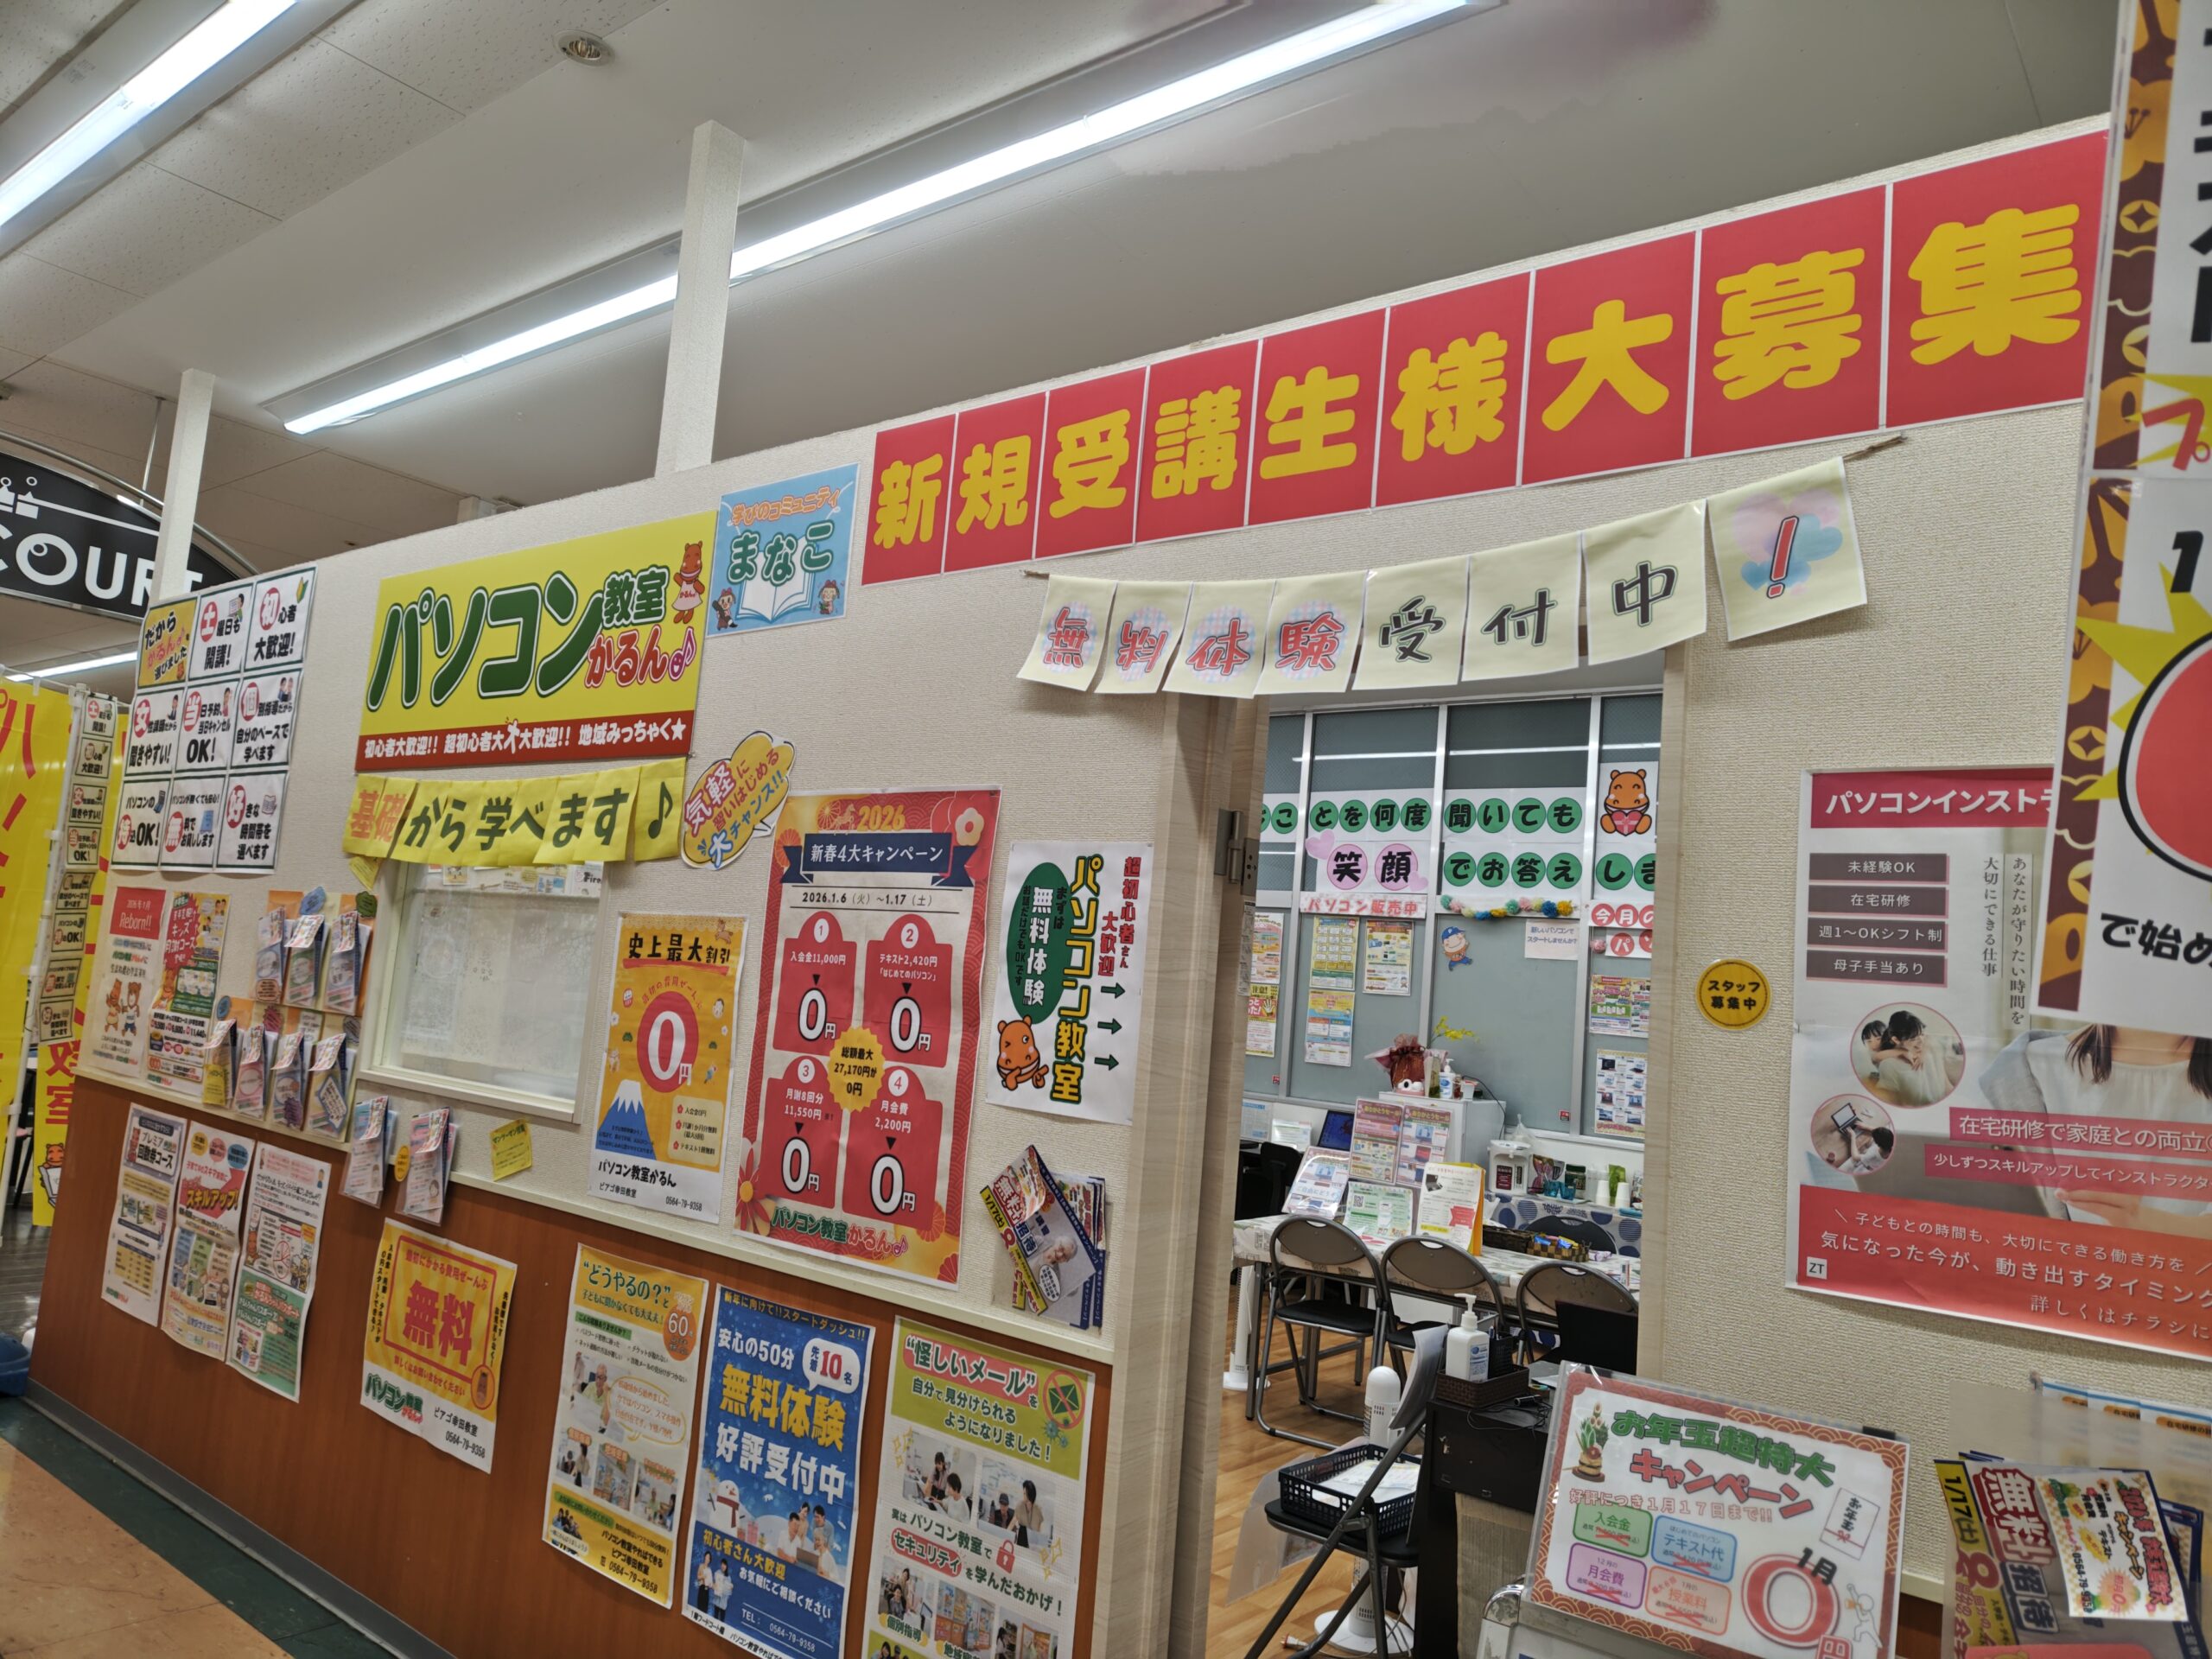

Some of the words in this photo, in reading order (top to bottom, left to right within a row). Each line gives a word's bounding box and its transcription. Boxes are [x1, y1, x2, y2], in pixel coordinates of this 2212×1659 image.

[873, 203, 2082, 549] 新規受講生様大募集
[732, 486, 840, 526] 学びのコミュニティ
[727, 519, 835, 587] まなこ
[258, 588, 296, 631] 初心者
[602, 564, 670, 629] 教室
[1043, 513, 1801, 677] 無料体験受付中!
[145, 612, 176, 650] だから
[200, 601, 240, 642] 土曜日も
[204, 645, 232, 670] 開講!
[254, 632, 295, 662] 大歓迎!
[366, 570, 605, 712] パソコン
[584, 625, 669, 688] かるん
[154, 645, 188, 680] 選びました
[198, 719, 231, 734] 当日キャンセル
[236, 723, 289, 745] 自分のペースで
[129, 745, 171, 767] 聞きやすい!
[186, 738, 215, 764] OK!
[243, 745, 276, 762] 学べます
[365, 736, 439, 759] 初心者大歓迎!!
[125, 796, 155, 810] パソコンの
[685, 760, 750, 837] 気軽に
[713, 748, 779, 831] 習いはじめる
[226, 785, 259, 829] 好きな
[709, 770, 785, 868] 大チャンス!!
[857, 804, 906, 831] 2026
[181, 830, 214, 849] お貸しします
[239, 826, 271, 841] 時間帯を
[73, 849, 91, 862] OK!
[237, 842, 269, 861] 選べます
[810, 843, 943, 863] 新春4大キャンペーン
[1848, 861, 1916, 874] 未経験OK
[1053, 887, 1068, 930] まずは
[1119, 856, 1141, 969] 超初心者さん
[1308, 899, 1419, 918] パソコン販売中
[1851, 893, 1911, 907] 在宅研修
[1982, 856, 1999, 976] 大切にできる仕事
[119, 912, 152, 931] Reborn!!
[1530, 925, 1573, 935] 新しいパソコンで
[628, 932, 731, 966] 史上最大割引
[1023, 887, 1054, 1007] 無料体験
[1098, 912, 1119, 977] 大歓迎
[2010, 857, 2026, 1025] あなたが守りたい時間を
[2101, 912, 2212, 969] で始め
[791, 951, 846, 965] 入会金11,000円
[880, 953, 938, 968] テキスト2,420円
[1834, 959, 1924, 976] 母子手当あり
[880, 969, 937, 982] 「はじめてのパソコン」
[1050, 854, 1104, 1105] パソコン教室
[1707, 980, 1760, 993] スタッフ
[798, 988, 836, 1041] 0円
[1711, 996, 1757, 1011] 募集中
[889, 996, 931, 1052] 0円
[648, 1010, 692, 1086] 0円
[842, 1046, 874, 1061] 総額最大
[834, 1063, 877, 1078] 27,170円が
[785, 1088, 823, 1105] 月謝8回分
[847, 1082, 862, 1097] 0円
[784, 1105, 822, 1121] 11,550円
[880, 1100, 908, 1116] 月会費
[875, 1117, 912, 1134] 2,200円
[598, 1159, 677, 1188] パソコン教室かるん
[781, 1136, 820, 1194] 0円
[1934, 1153, 2212, 1191] 少しずつスキルアップしてインストラクタ
[599, 1182, 637, 1199] ピアゴ幸田教室
[870, 1154, 916, 1216] 0円
[665, 1196, 702, 1212] 0564-79-9358
[770, 1206, 848, 1243] パソコン教室
[849, 1224, 892, 1252] かるん
[1809, 1262, 1824, 1274] ZT
[403, 1279, 475, 1367] 無料
[668, 1312, 690, 1337] 60
[2031, 1295, 2211, 1341] 詳しくはチラシに
[718, 1328, 794, 1370] 安心の50分
[810, 1346, 819, 1372] 先着
[820, 1350, 842, 1381] 10
[843, 1372, 853, 1387] 名
[365, 1373, 423, 1414] パソコン教室
[719, 1363, 846, 1452] 無料体験
[912, 1377, 1016, 1425] 自分で見分けられる
[434, 1407, 477, 1438] ピアゴ幸田教室
[944, 1411, 1051, 1464] ようになりました!
[446, 1431, 486, 1459] 0564-79-9358
[1611, 1410, 1834, 1488] お年玉超特大
[715, 1422, 847, 1505] 好評受付中
[1630, 1448, 1814, 1519] キャンペーン
[1594, 1512, 1630, 1532] 入会金
[1944, 1476, 1979, 1544] 1/17(土)
[892, 1508, 906, 1524] 実は
[910, 1514, 992, 1560] パソコン教室で
[1664, 1535, 1725, 1562] テキスト代
[702, 1529, 785, 1581] 初心者さん大歓迎
[1798, 1548, 1838, 1586] 1月
[609, 1563, 658, 1594] 0564-79-9358
[1587, 1564, 1624, 1586] 月会費
[2072, 1553, 2092, 1614] 0564-79-9358
[739, 1567, 831, 1619] お気軽にご相談ください
[1669, 1588, 1707, 1611] 授業料
[1742, 1554, 1853, 1659] 0円
[769, 1623, 816, 1653] 0564-79-9358
[887, 1615, 922, 1643] 個別指導
